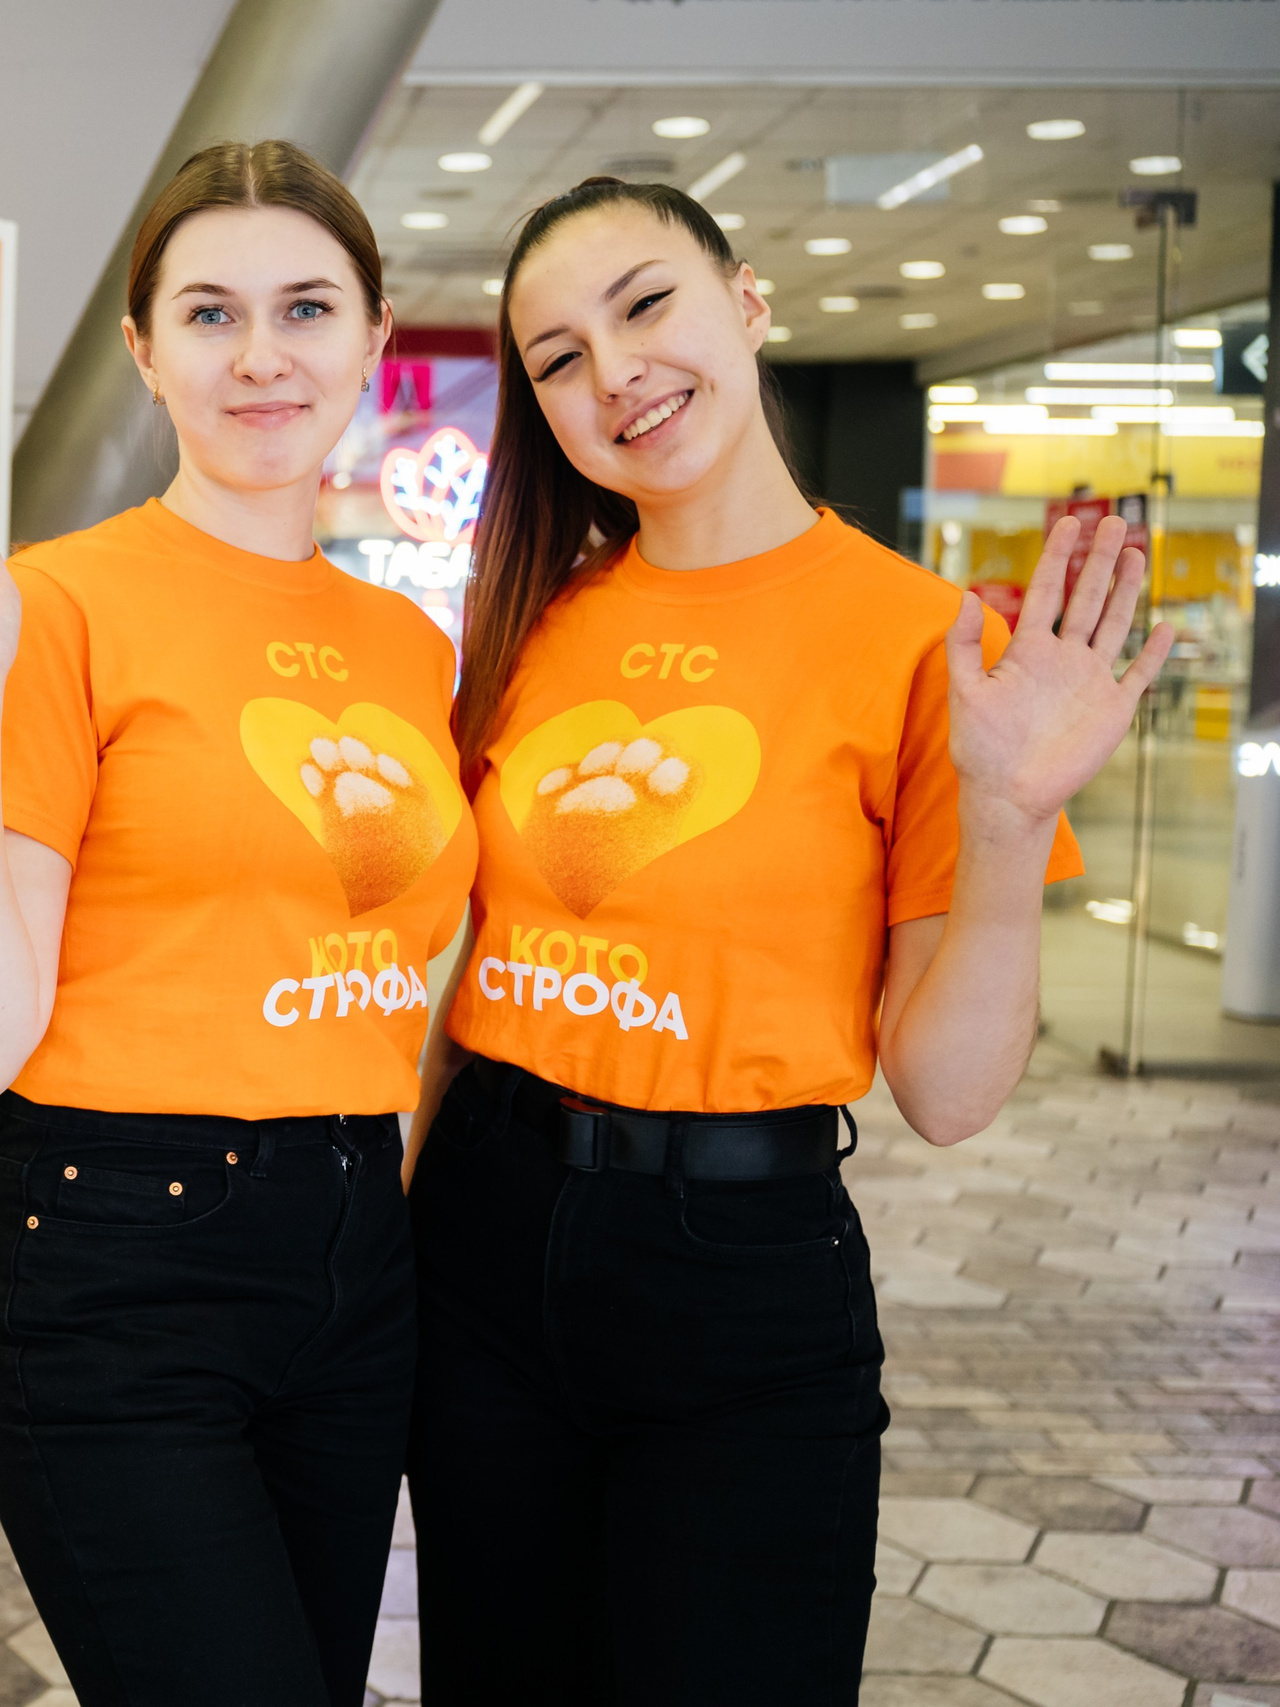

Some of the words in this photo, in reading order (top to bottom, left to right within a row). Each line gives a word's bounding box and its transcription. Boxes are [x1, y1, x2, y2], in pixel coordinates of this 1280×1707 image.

[358, 539, 472, 589] ТАБА
[266, 641, 349, 682] СТС
[620, 643, 718, 683] СТС
[510, 925, 649, 986] КОТО
[478, 957, 689, 1040] СТРОФА
